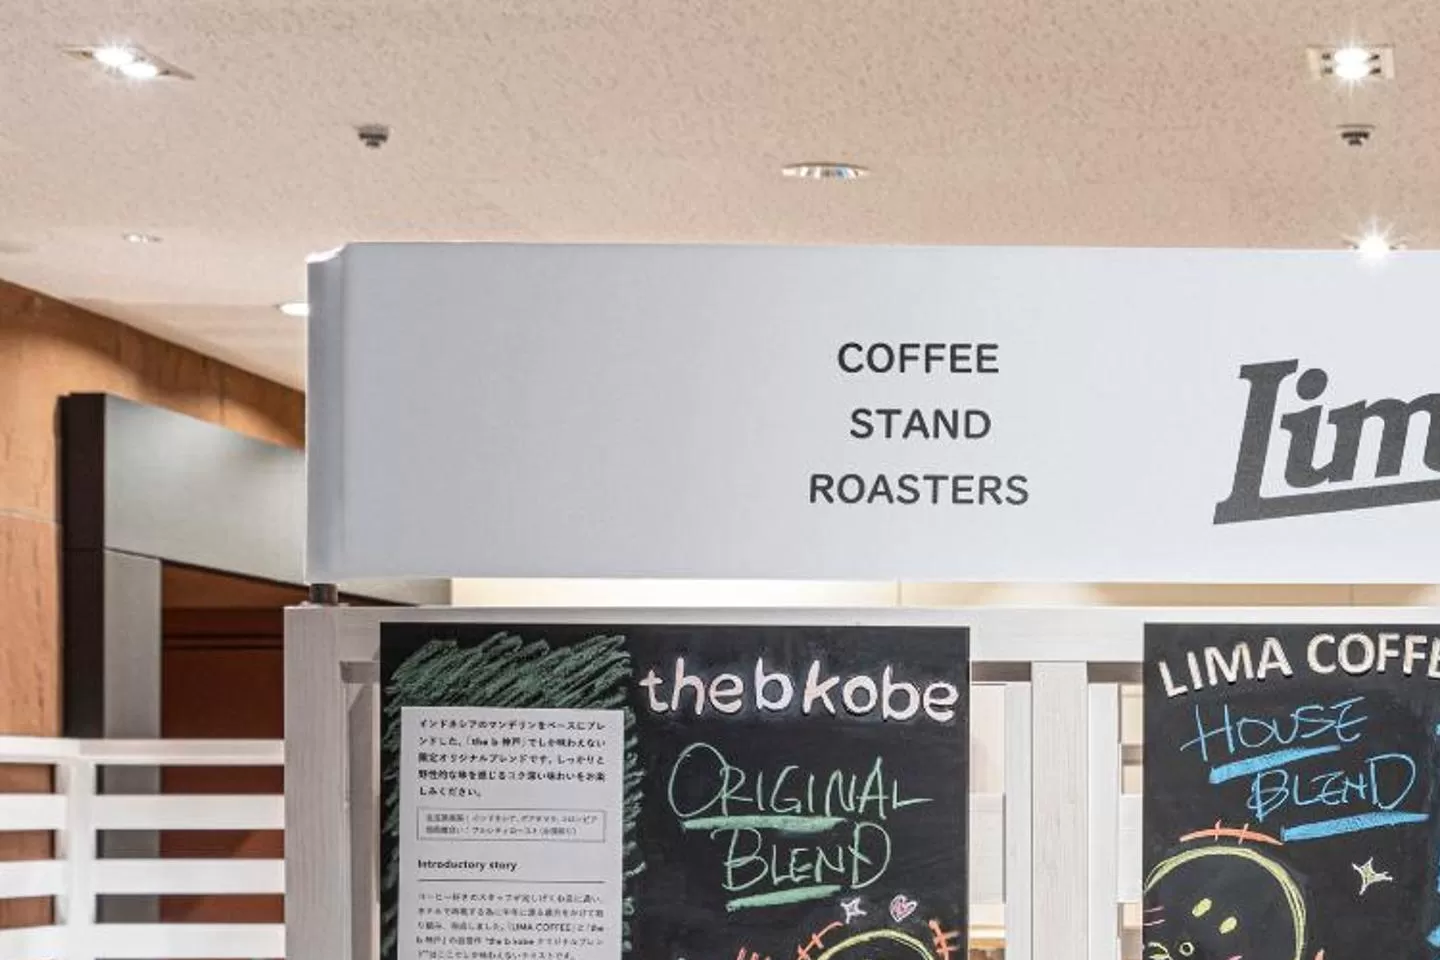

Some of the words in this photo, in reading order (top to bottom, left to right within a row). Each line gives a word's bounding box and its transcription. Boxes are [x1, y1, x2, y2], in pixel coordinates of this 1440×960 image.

[838, 342, 999, 374] COFFEE
[850, 408, 991, 440] STAND
[809, 473, 1029, 505] ROASTERS
[1158, 639, 1292, 697] LIMA
[1180, 697, 1368, 761] HOUSE
[668, 743, 934, 819] ORIGINAL
[1247, 753, 1416, 820] BLEND
[418, 859, 485, 872] Introductory
[489, 861, 518, 872] story
[710, 822, 891, 890] BLEND
